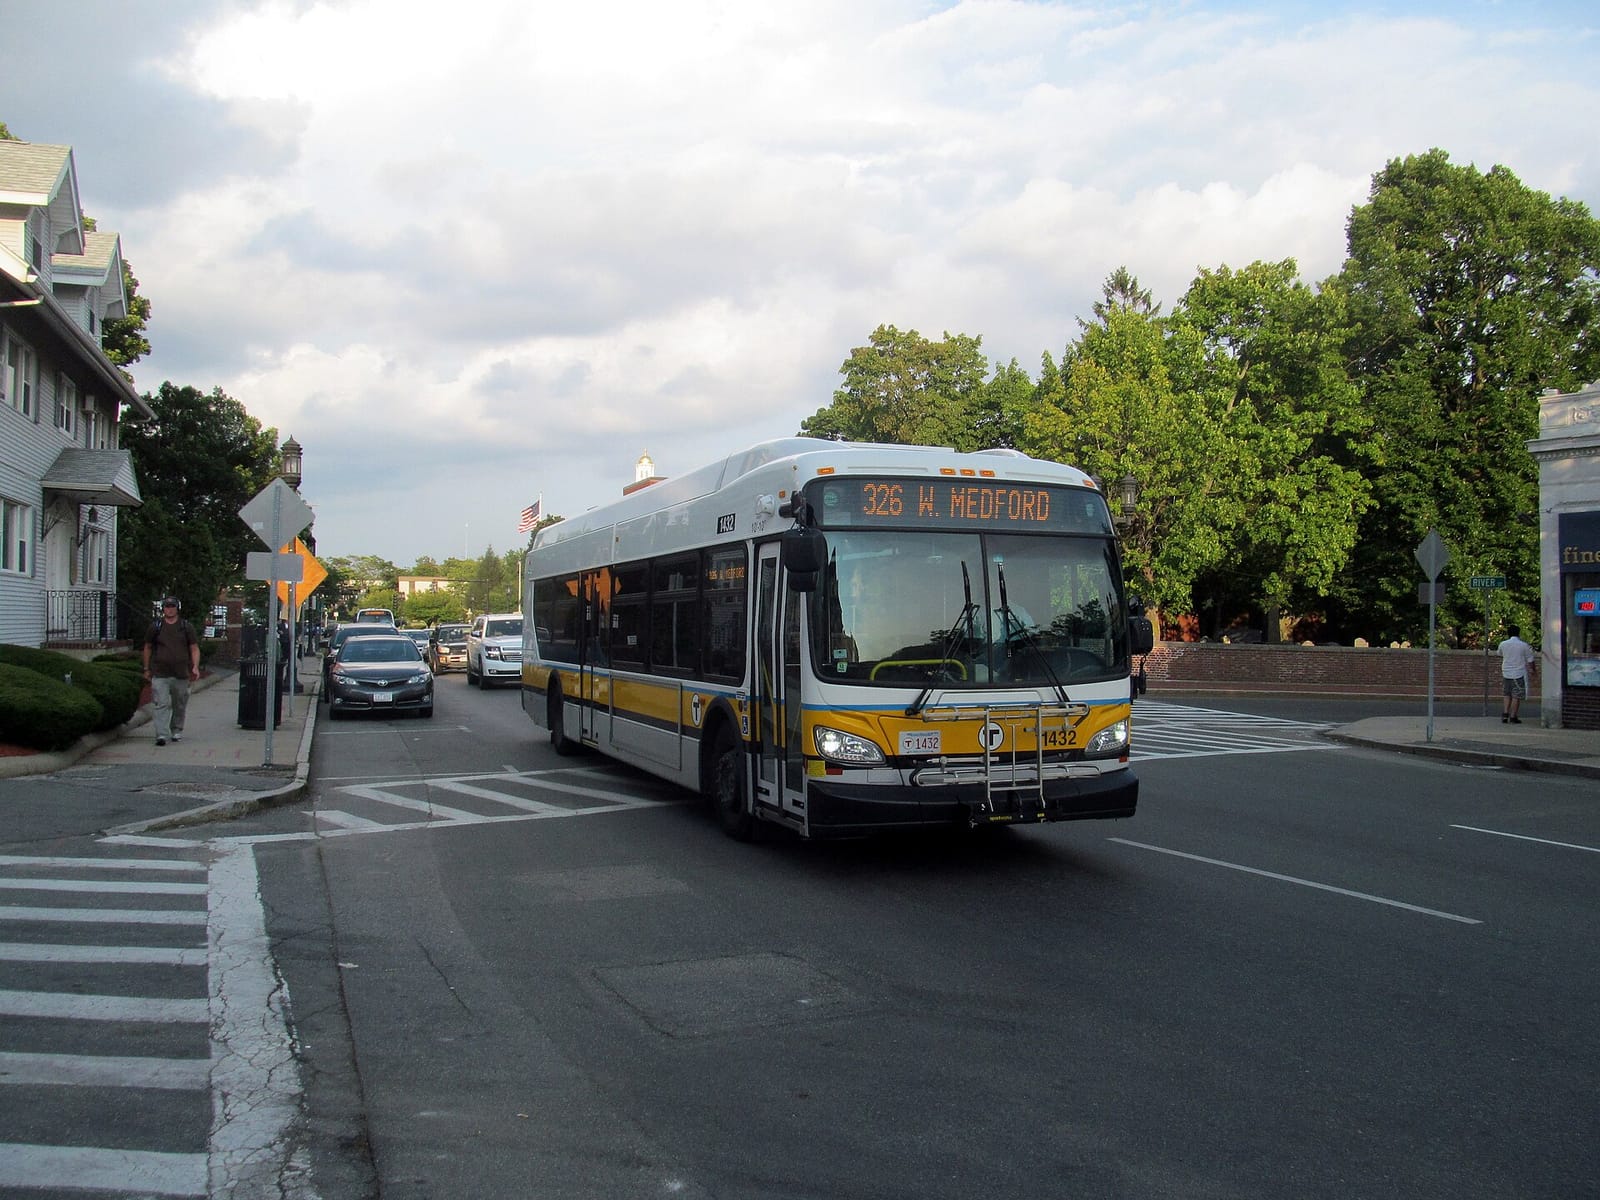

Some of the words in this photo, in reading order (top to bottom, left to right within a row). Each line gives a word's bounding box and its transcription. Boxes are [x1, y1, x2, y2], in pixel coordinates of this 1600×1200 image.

[863, 483, 903, 516] 326
[918, 485, 940, 517] W.
[951, 487, 1049, 521] MEDFORD
[719, 514, 734, 533] 1432
[1472, 578, 1496, 587] RIVER
[915, 737, 939, 749] 1432
[1042, 730, 1077, 747] 1432
